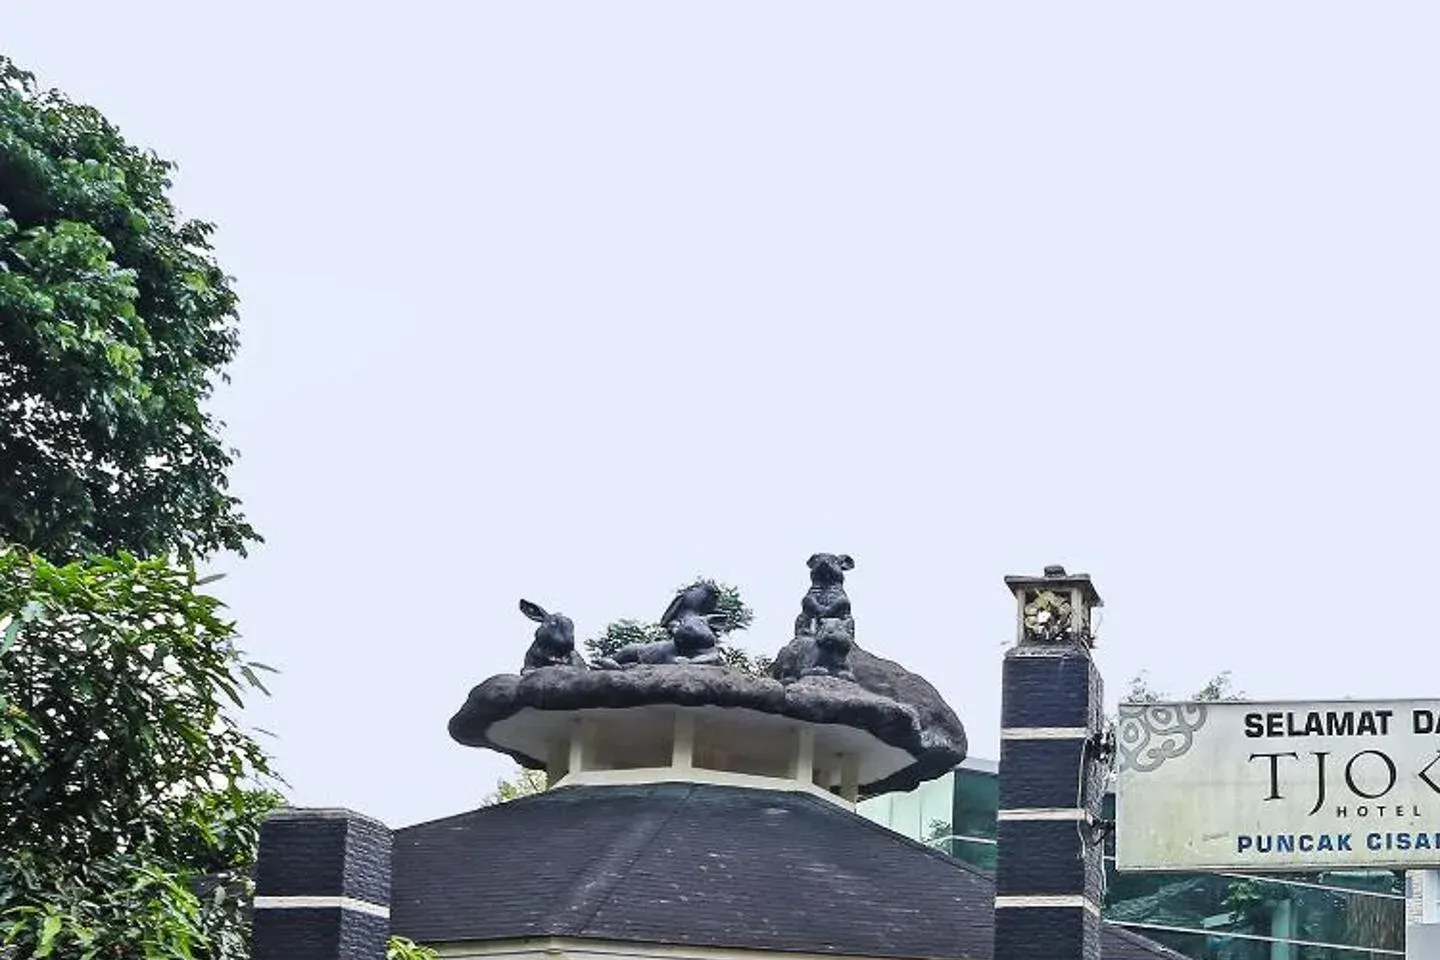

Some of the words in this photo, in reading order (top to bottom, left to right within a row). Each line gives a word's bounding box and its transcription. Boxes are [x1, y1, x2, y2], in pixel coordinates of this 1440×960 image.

[1244, 710, 1393, 738] SELAMAT
[1336, 805, 1421, 817] HOTEL
[1237, 834, 1352, 853] PUNCAK
